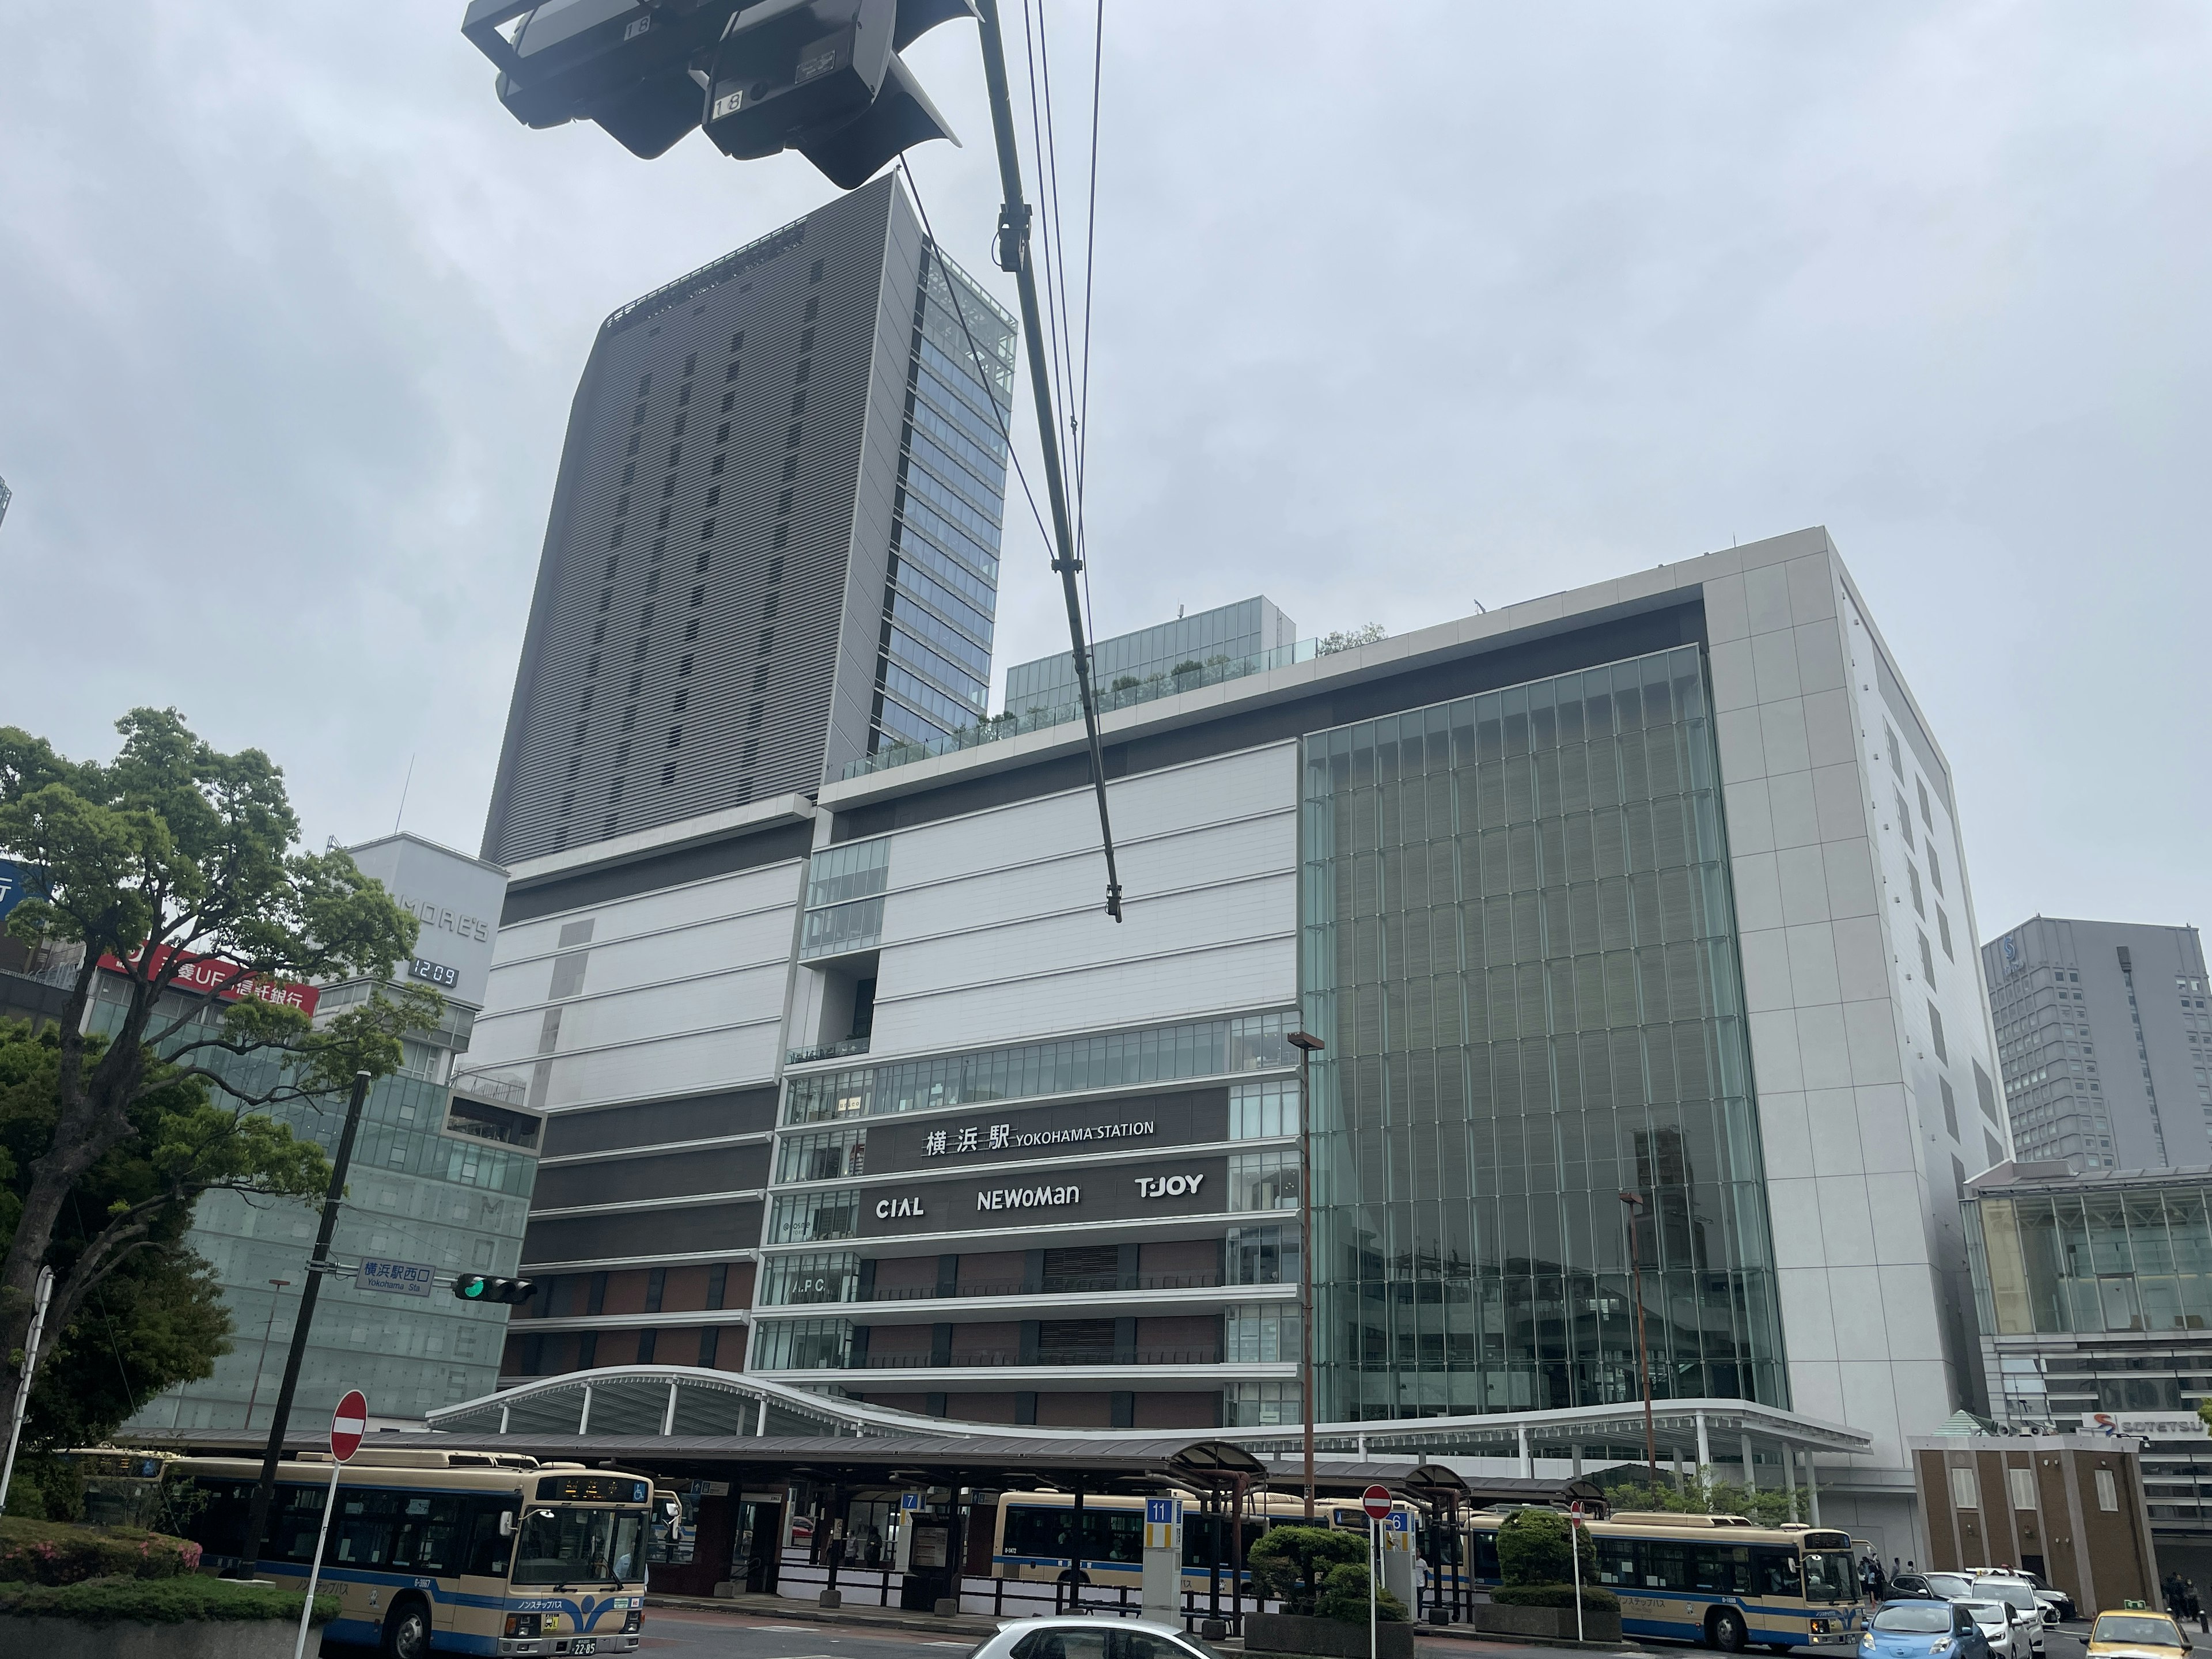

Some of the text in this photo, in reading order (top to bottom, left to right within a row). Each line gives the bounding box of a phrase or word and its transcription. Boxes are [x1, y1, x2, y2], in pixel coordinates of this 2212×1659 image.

[627, 17, 648, 38] 18
[716, 93, 740, 116] 18
[400, 894, 489, 942] MORE'S
[926, 1121, 1154, 1156] 横浜駅 YOKOHAMA STATION
[876, 1197, 925, 1218] CIAL
[783, 1222, 810, 1231] @osme
[364, 1262, 430, 1283] 横浜駅西口
[368, 1278, 421, 1292] Yokohama Sta
[2121, 1421, 2204, 1433] SOTETSU
[907, 1495, 914, 1508] 7
[1153, 1502, 1165, 1521] 11
[1392, 1514, 1401, 1530] 6
[296, 1578, 349, 1596] ノンテップバス
[518, 1601, 562, 1609] ノンステップバス
